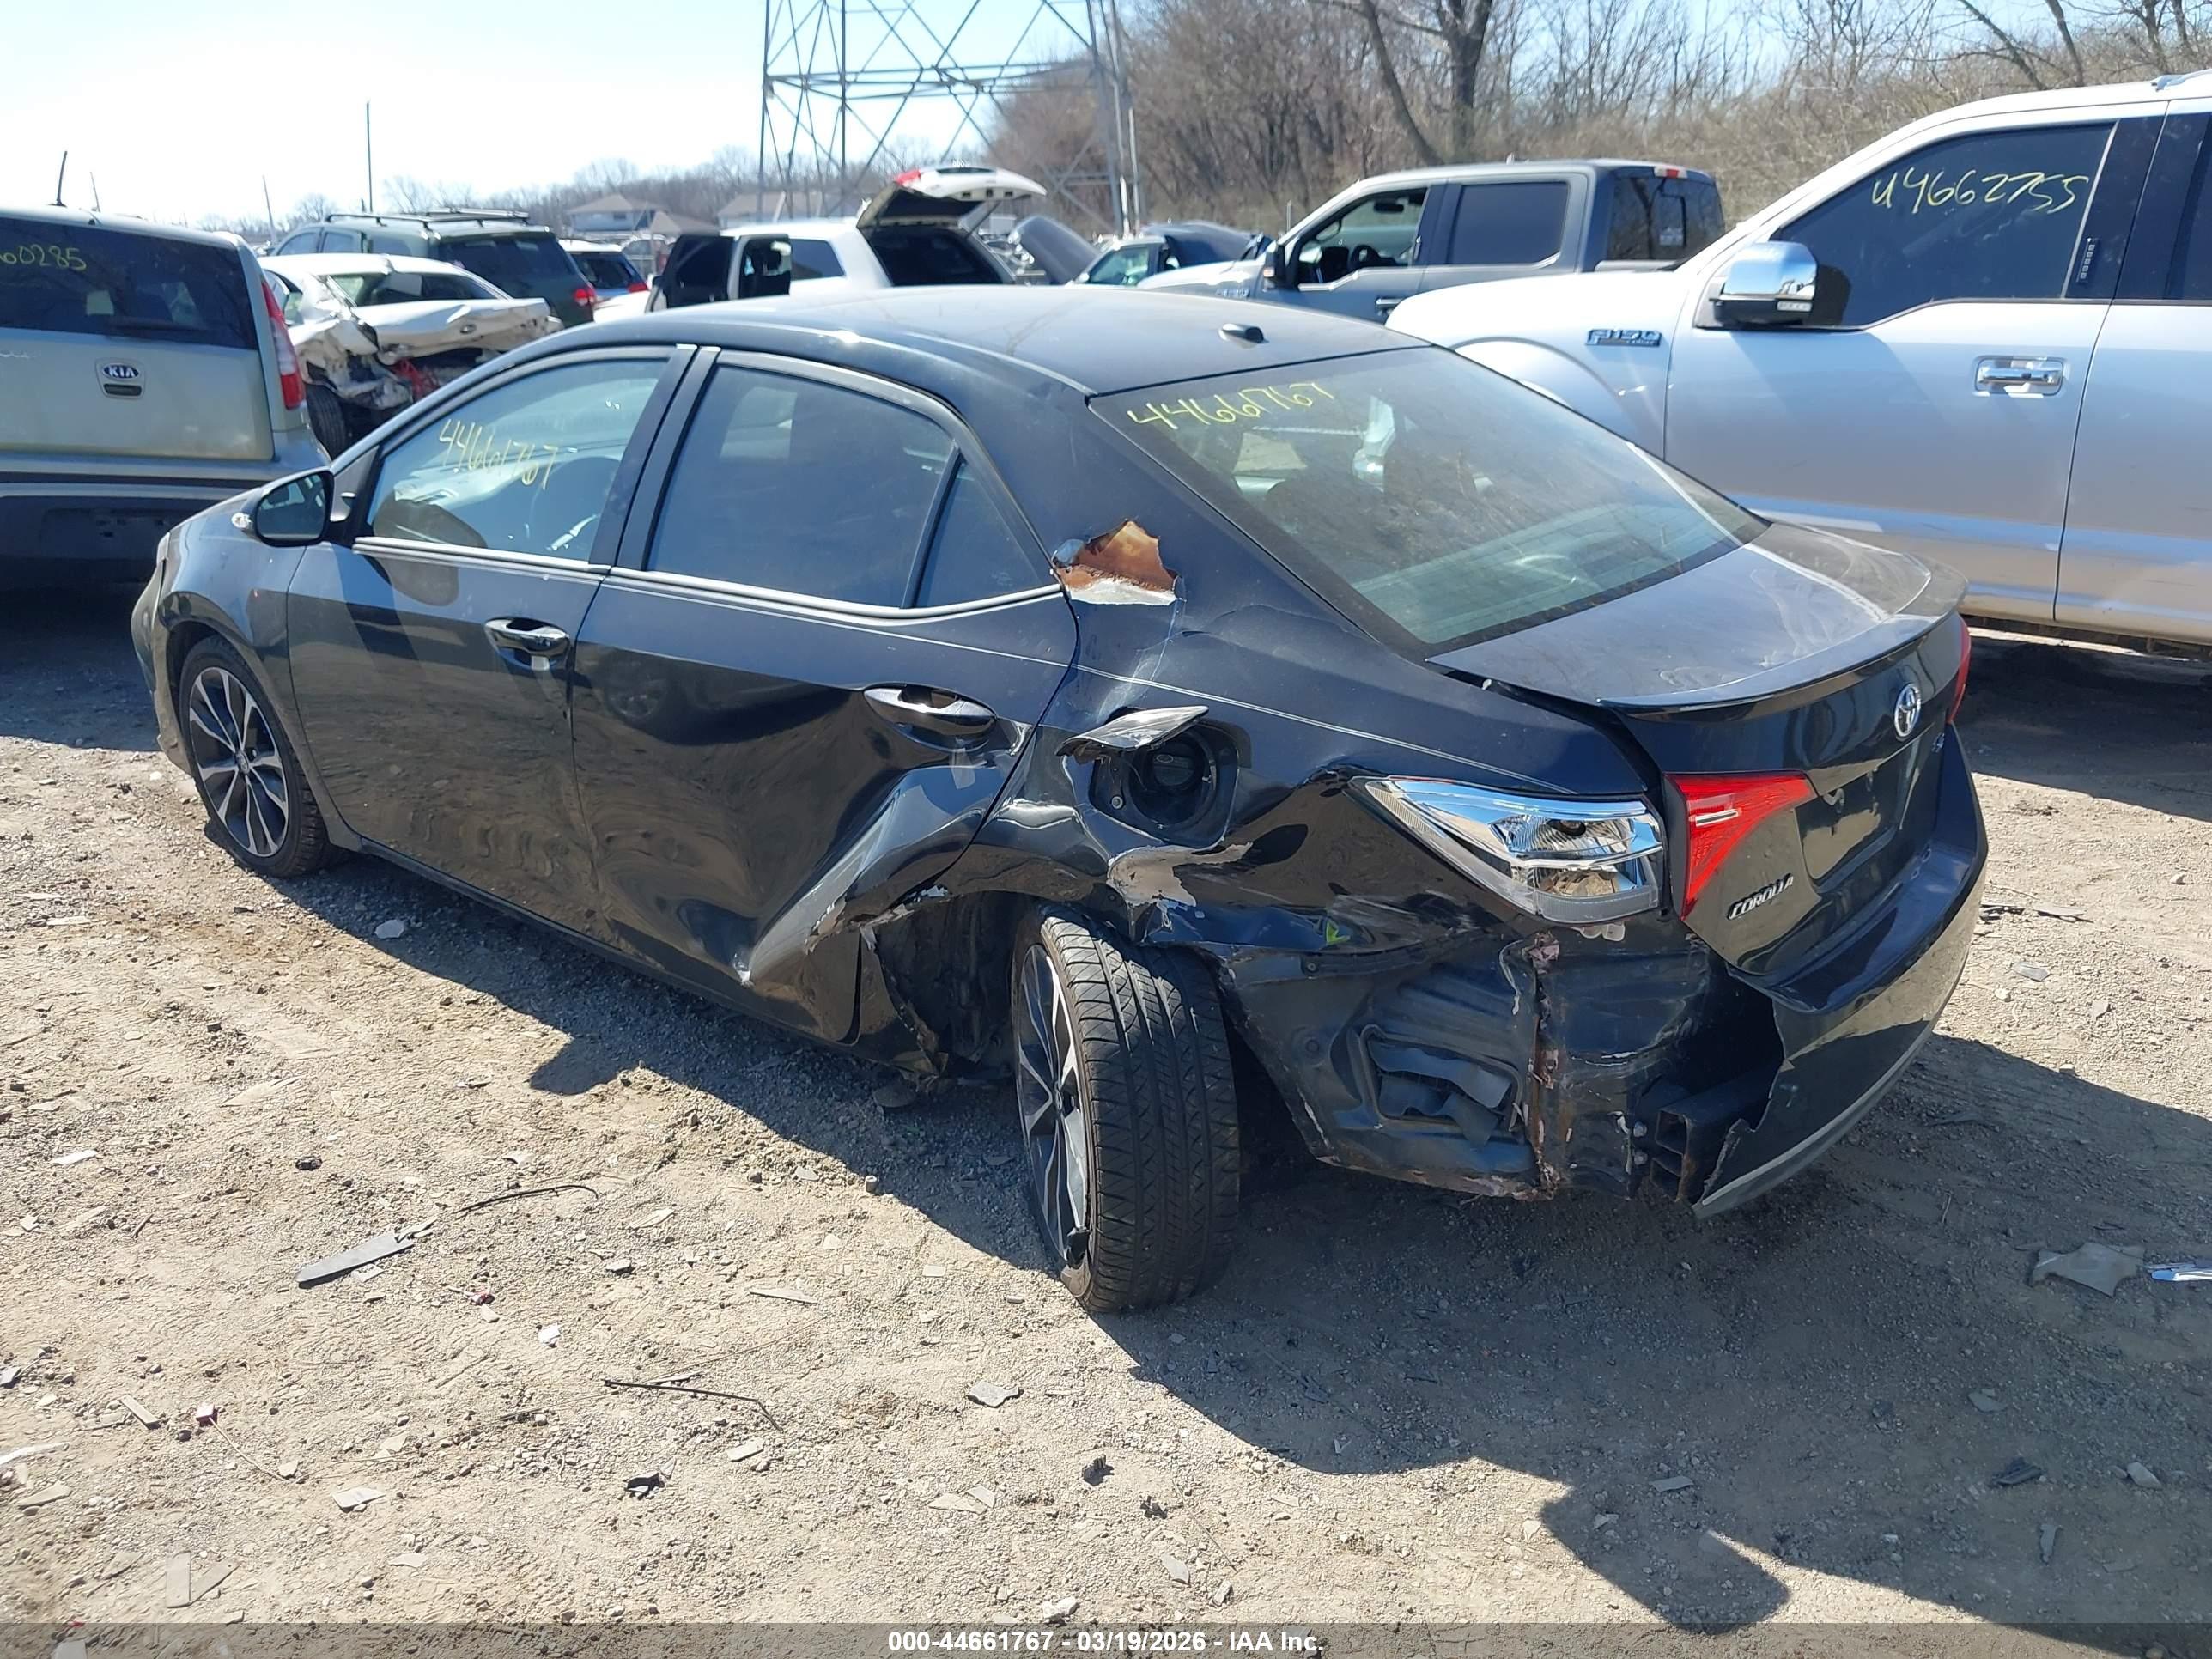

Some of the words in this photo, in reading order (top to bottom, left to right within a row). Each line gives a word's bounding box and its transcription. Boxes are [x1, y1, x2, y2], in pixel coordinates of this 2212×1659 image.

[109, 366, 136, 377] KIA
[1127, 382, 1334, 429] 44661767
[439, 418, 559, 490] 44661767
[1727, 873, 1795, 921] COROLLA
